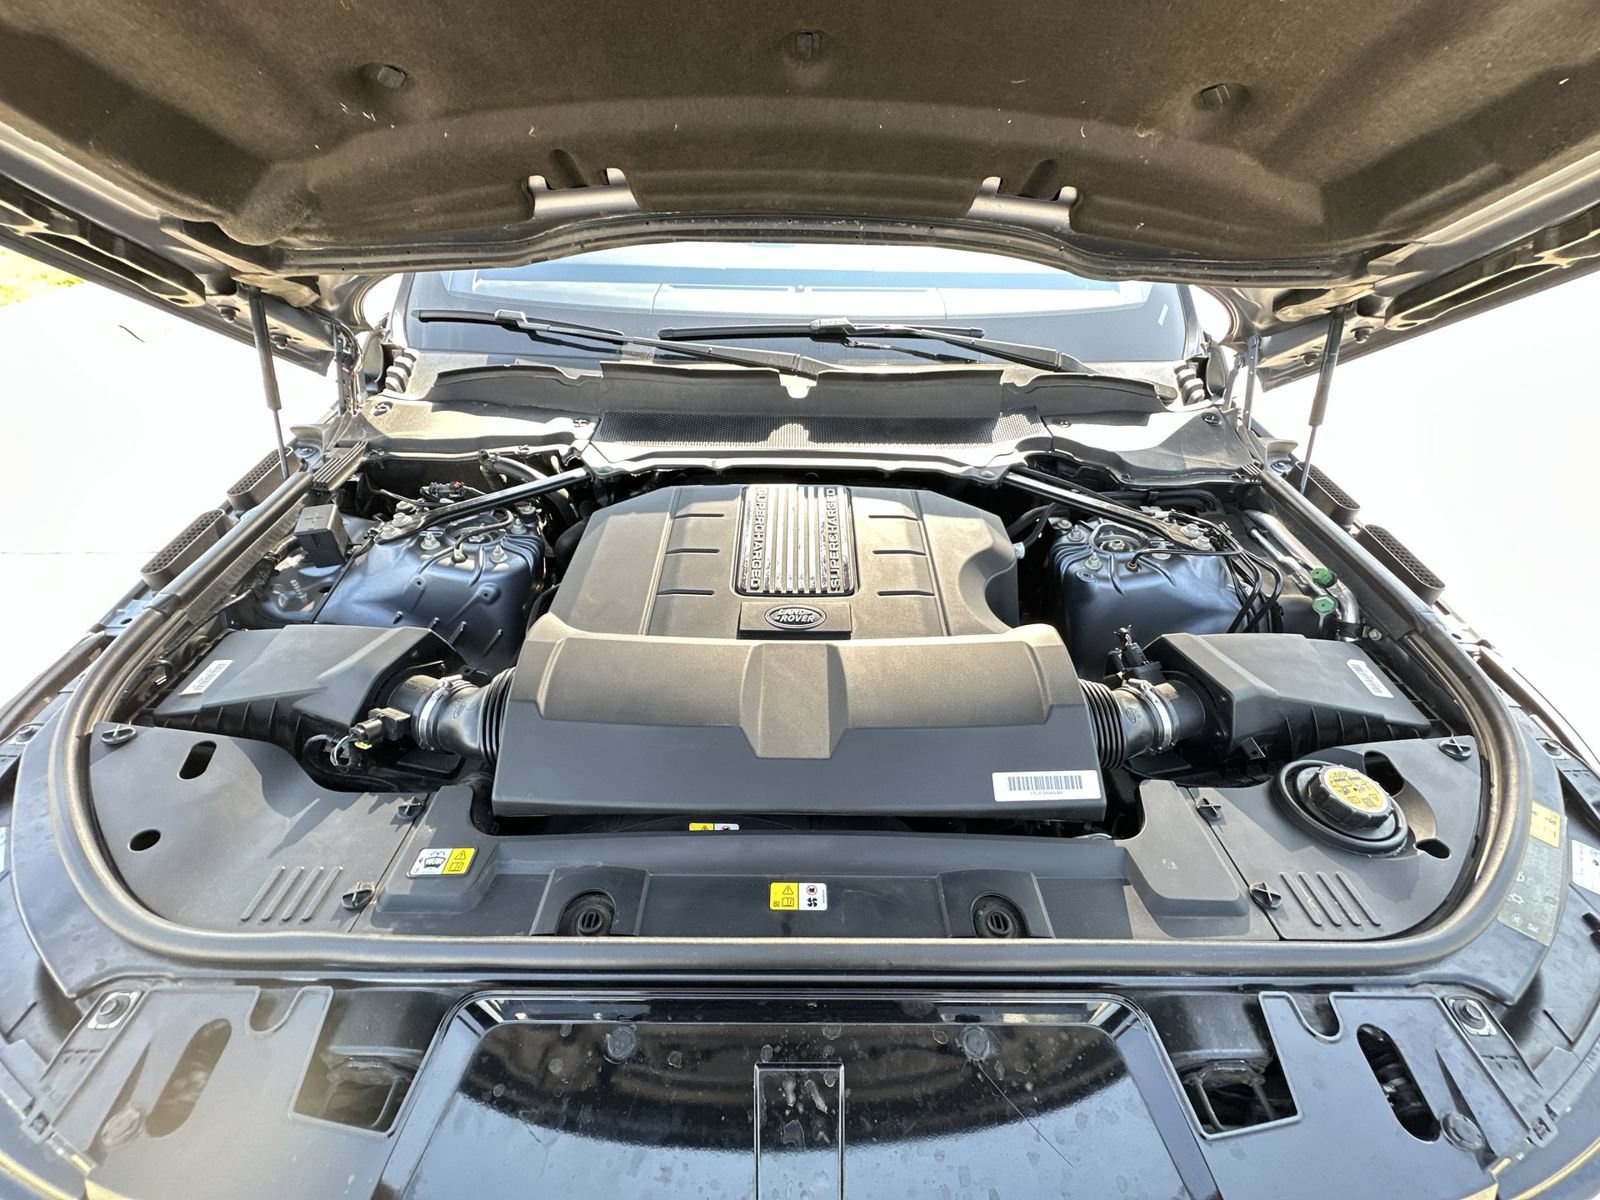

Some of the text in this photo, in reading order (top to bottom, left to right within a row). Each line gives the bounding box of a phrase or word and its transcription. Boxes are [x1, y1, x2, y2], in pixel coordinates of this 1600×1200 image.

[750, 487, 768, 591] SUPERCHARGED
[826, 488, 841, 592] SUPERCHARGED
[779, 615, 815, 623] ROVER
